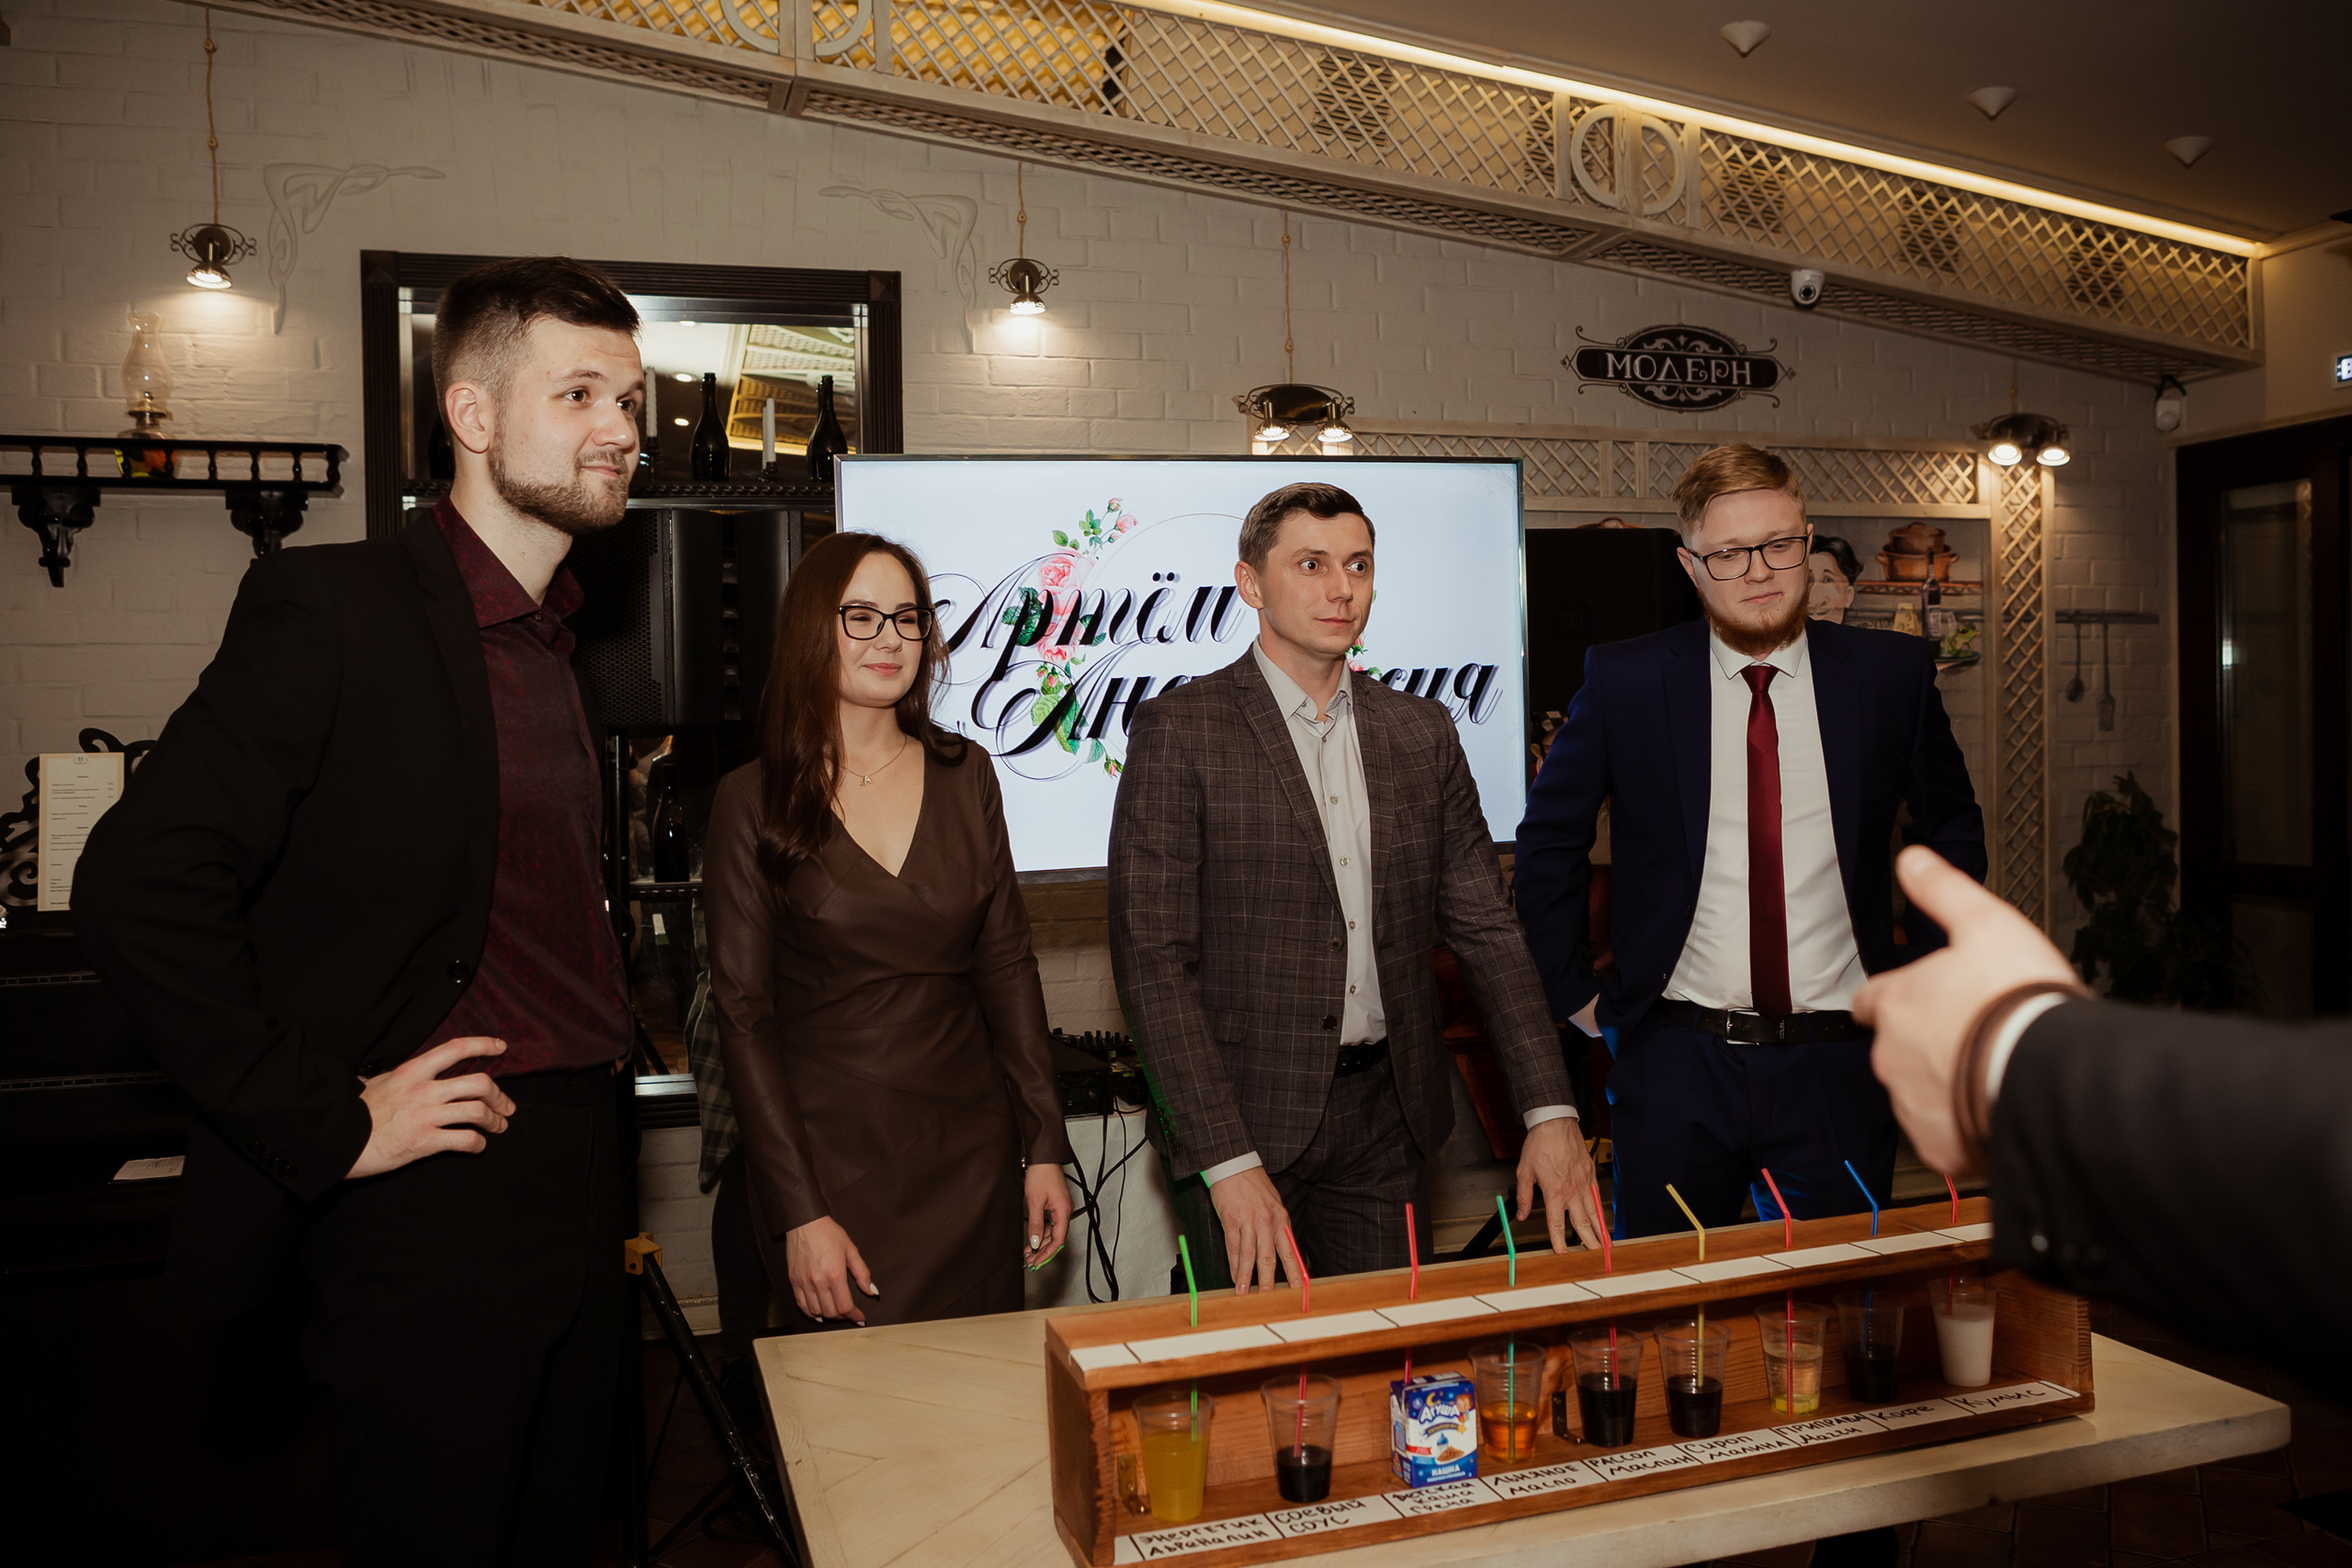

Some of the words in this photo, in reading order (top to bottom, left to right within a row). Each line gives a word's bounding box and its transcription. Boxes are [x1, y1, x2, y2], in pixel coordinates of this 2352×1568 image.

[1605, 352, 1752, 386] МОДЕРН
[928, 553, 1242, 685] Артём
[1872, 1404, 1935, 1422] Кофе
[1776, 1412, 1870, 1436] ПРИПРАВА
[1684, 1435, 1755, 1454] Сироп
[1289, 1516, 1350, 1534] СОУС
